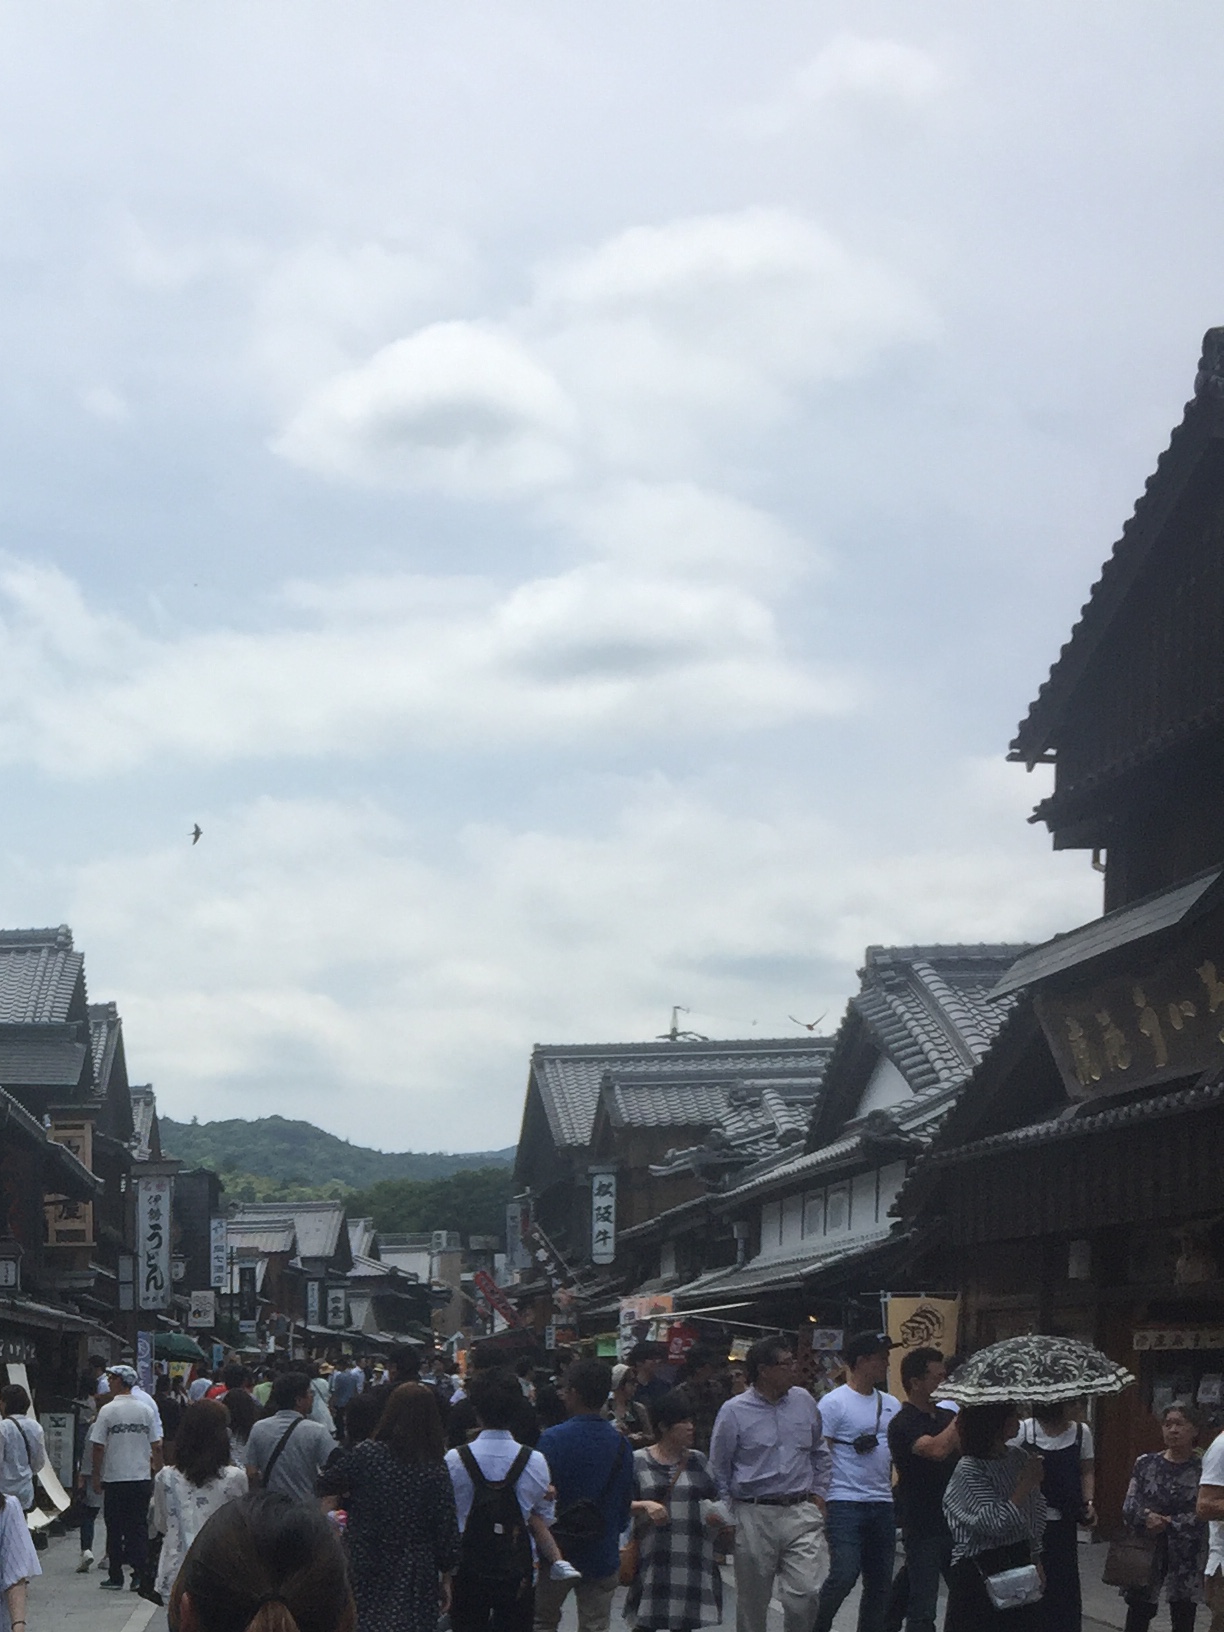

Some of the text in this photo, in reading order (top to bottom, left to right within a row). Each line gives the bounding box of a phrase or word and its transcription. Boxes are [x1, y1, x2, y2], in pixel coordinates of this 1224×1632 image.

[145, 1194, 164, 1293] 伊勢うどん
[595, 1181, 614, 1246] 松阪牛
